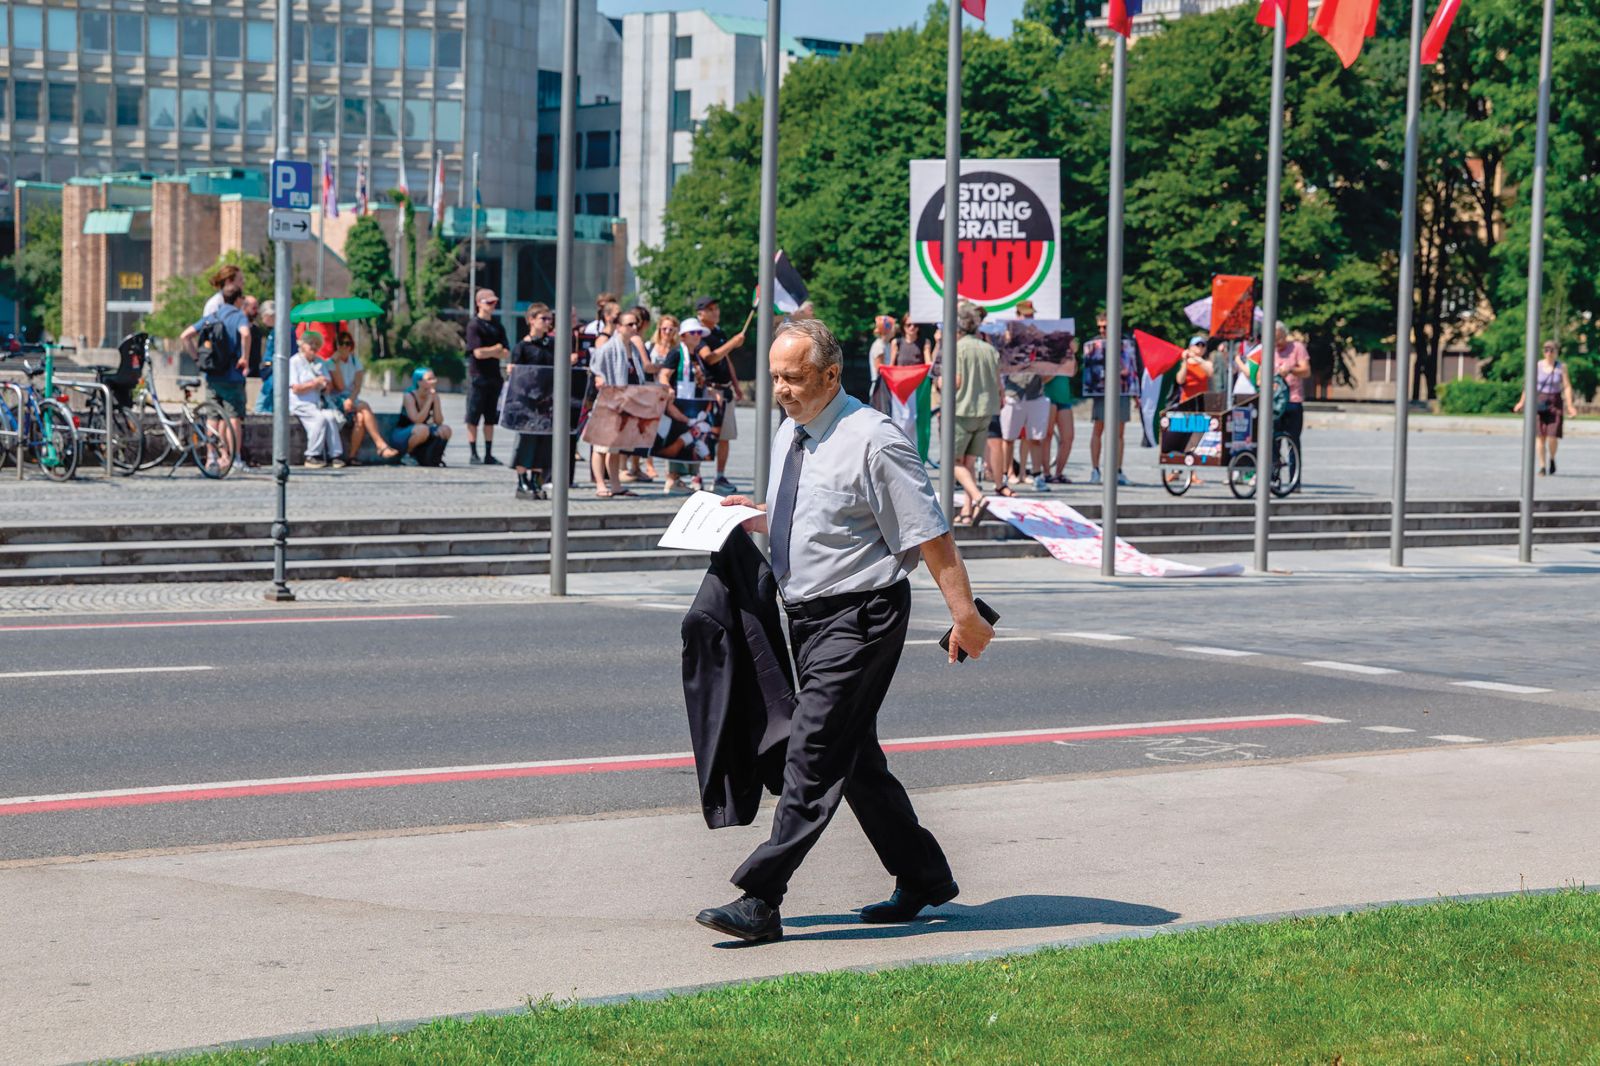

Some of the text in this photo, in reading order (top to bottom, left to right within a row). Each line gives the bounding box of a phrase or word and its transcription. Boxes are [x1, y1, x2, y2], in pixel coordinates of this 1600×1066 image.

[276, 165, 297, 199] P
[958, 182, 1016, 202] STOP
[938, 201, 1033, 221] RMING
[957, 220, 1027, 239] SRAEL
